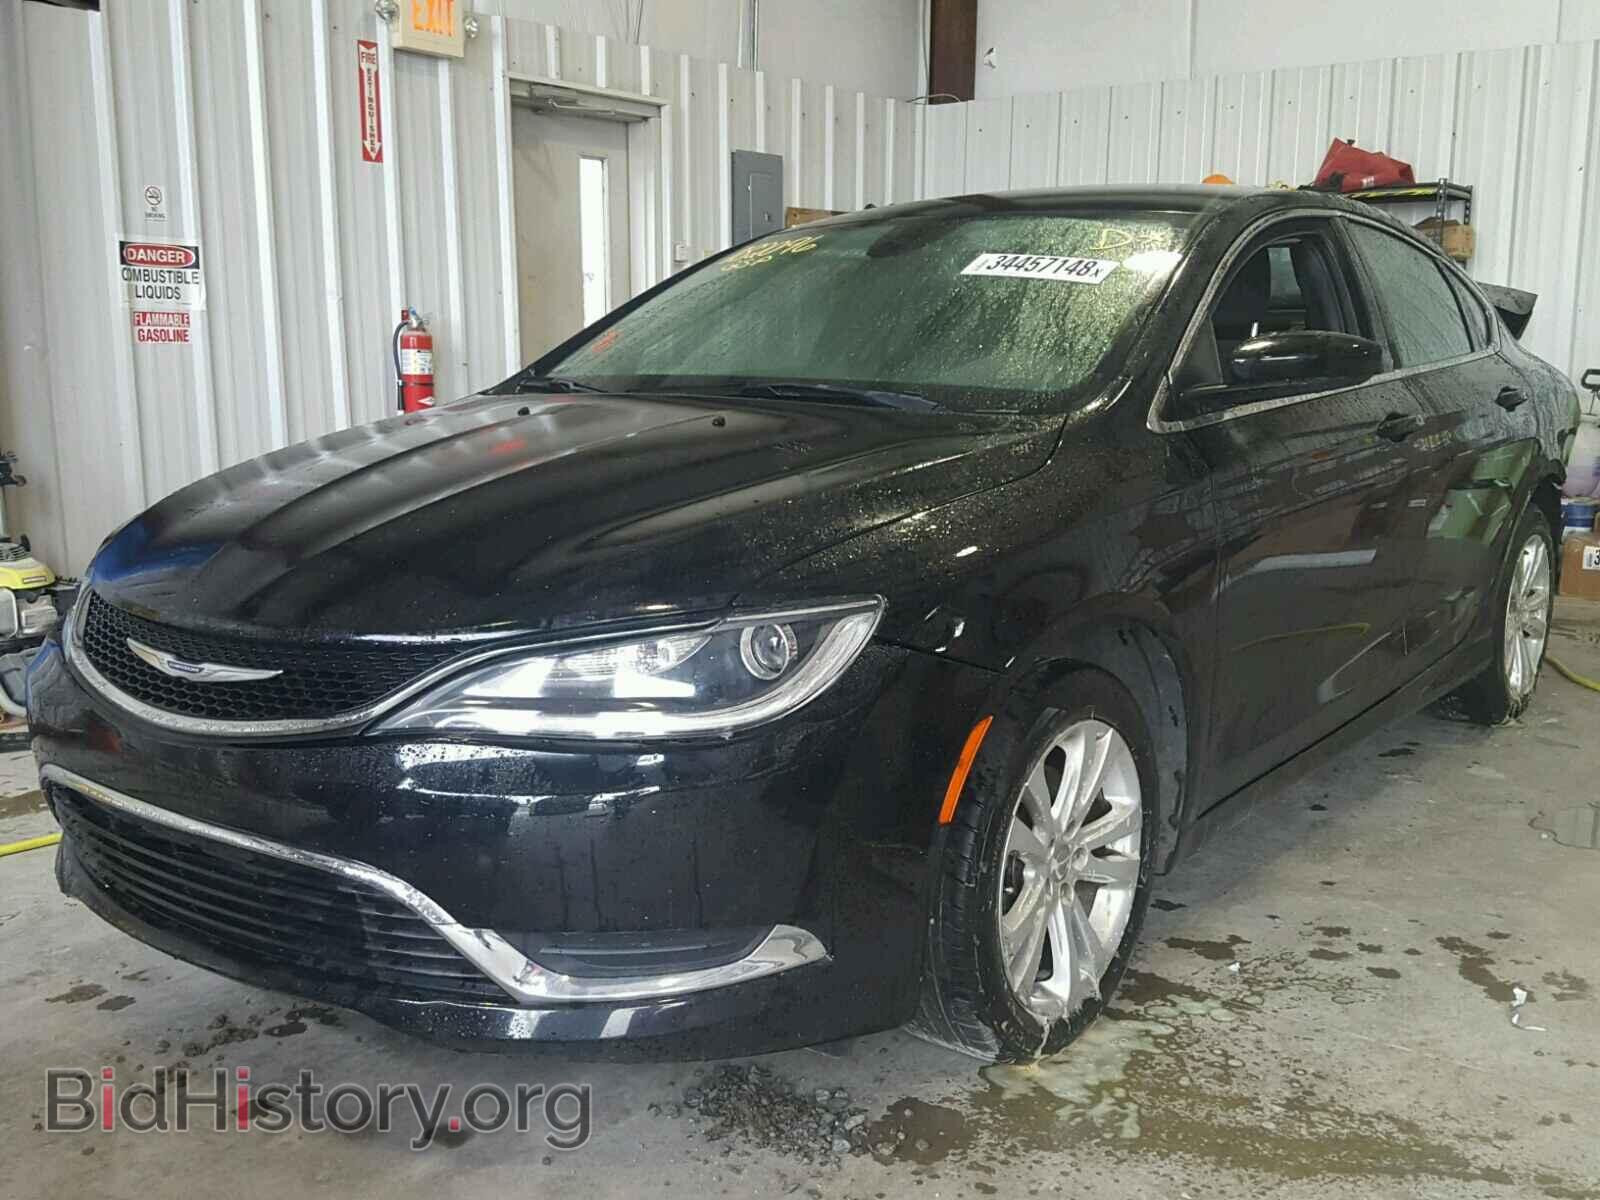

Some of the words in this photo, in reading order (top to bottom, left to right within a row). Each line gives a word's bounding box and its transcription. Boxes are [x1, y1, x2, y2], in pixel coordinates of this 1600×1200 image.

[127, 248, 185, 263] DANGER
[121, 267, 199, 285] COMBUSTIBLE
[135, 285, 182, 301] LIQUIDS
[134, 312, 190, 327] FLAMMABLE
[137, 328, 190, 343] GASOLINE
